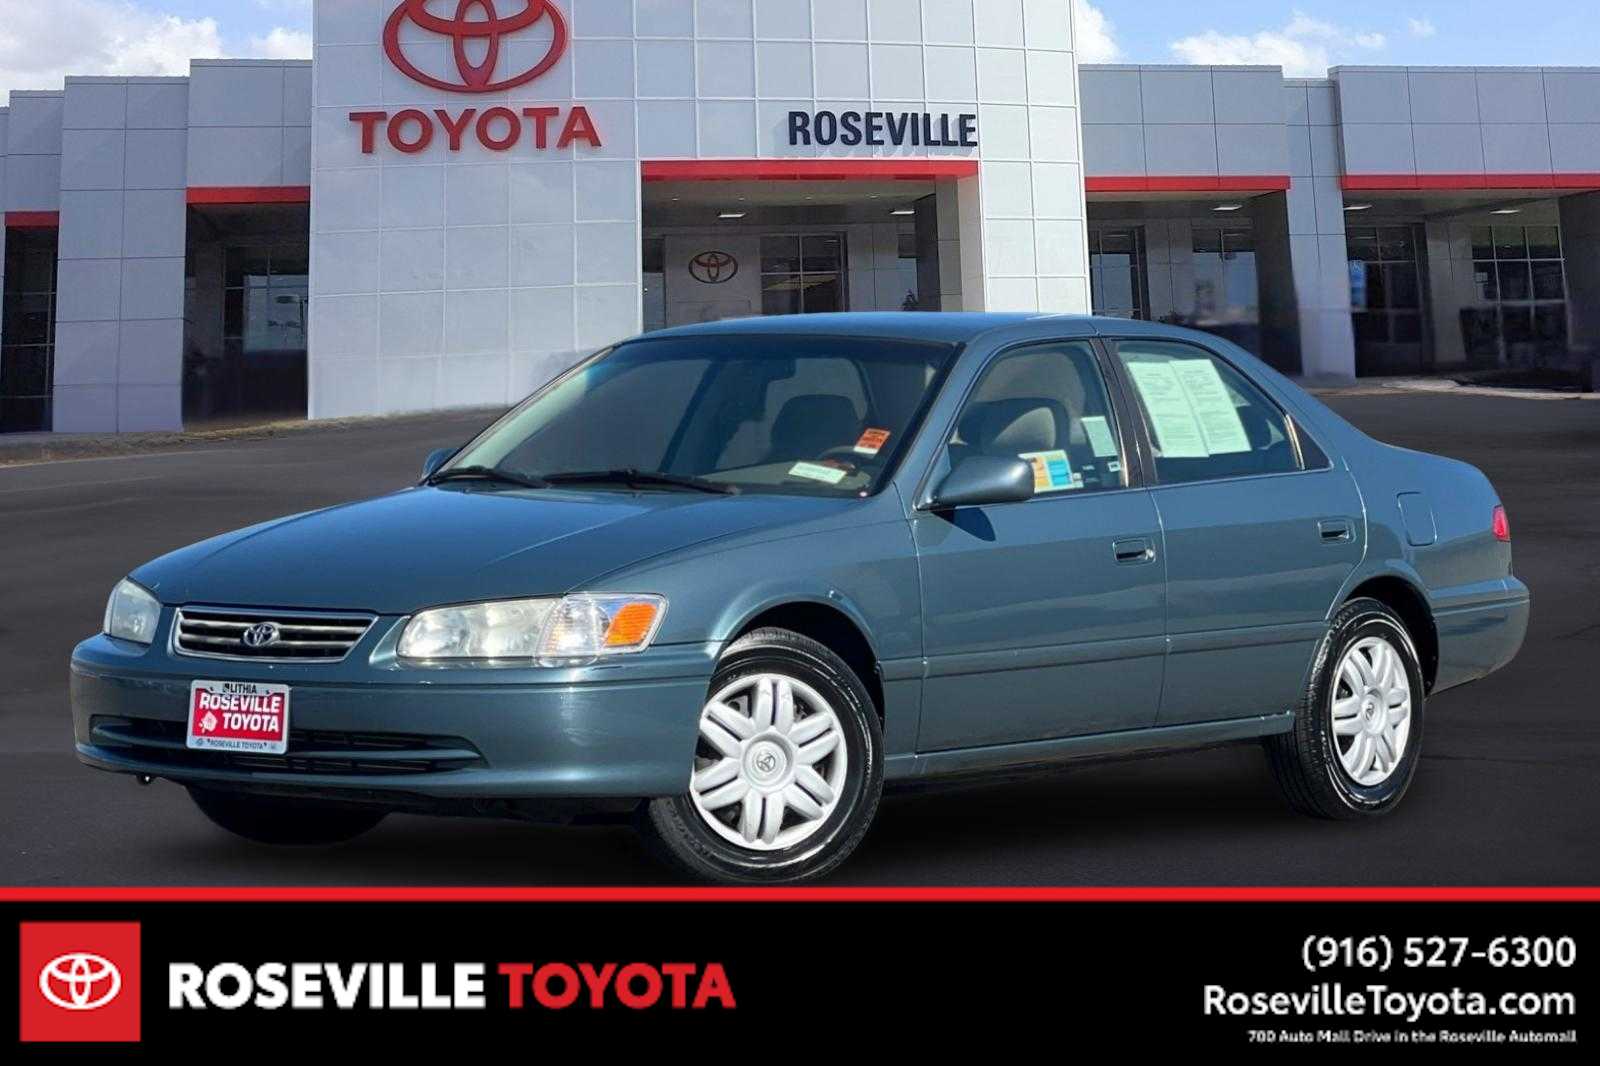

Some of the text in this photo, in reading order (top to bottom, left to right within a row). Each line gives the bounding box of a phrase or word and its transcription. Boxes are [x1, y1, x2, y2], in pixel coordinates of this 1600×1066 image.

[349, 106, 602, 154] TOYOTA
[788, 110, 978, 147] ROSEVILLE
[230, 683, 257, 694] LITHIA
[199, 692, 282, 713] ROSEVILLE
[222, 712, 279, 733] TOYOTA
